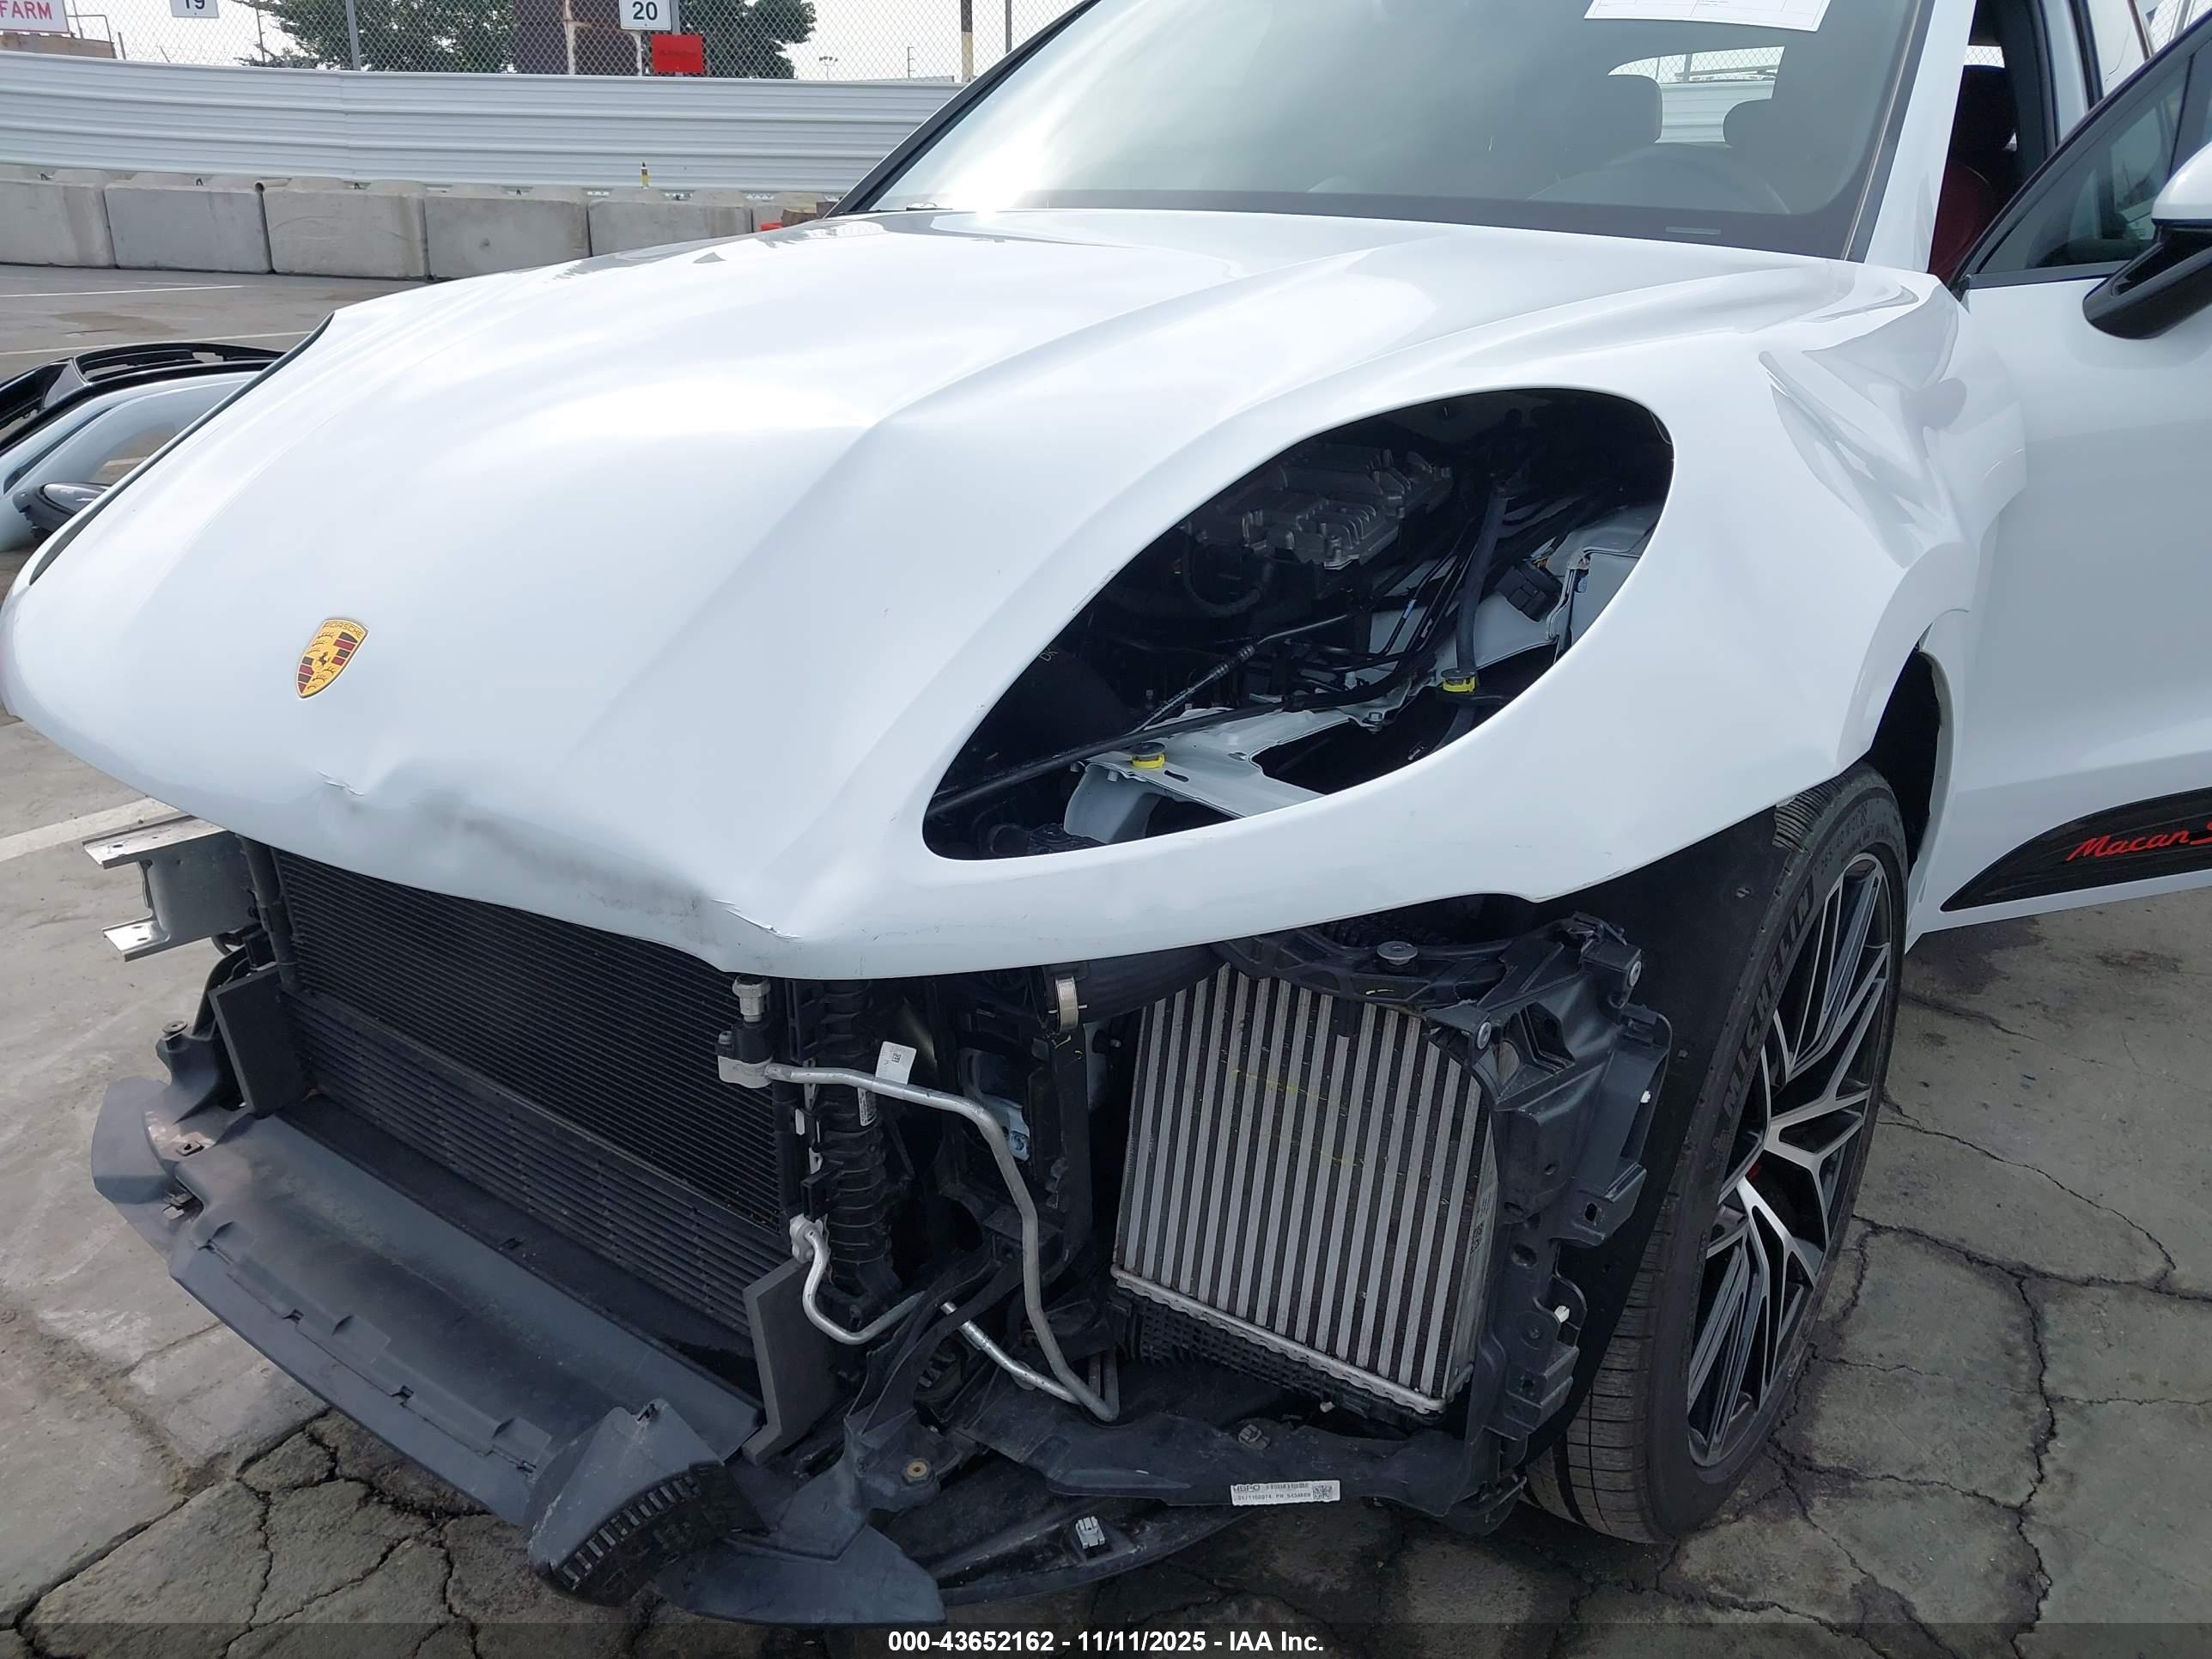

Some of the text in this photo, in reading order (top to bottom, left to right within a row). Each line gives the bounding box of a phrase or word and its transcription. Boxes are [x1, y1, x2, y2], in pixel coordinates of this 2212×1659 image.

[0, 0, 52, 21] FARM
[632, 1, 658, 21] 20
[323, 623, 363, 638] PORSCHE
[2065, 829, 2191, 862] Macan
[1723, 884, 1812, 1117] MICHELIN
